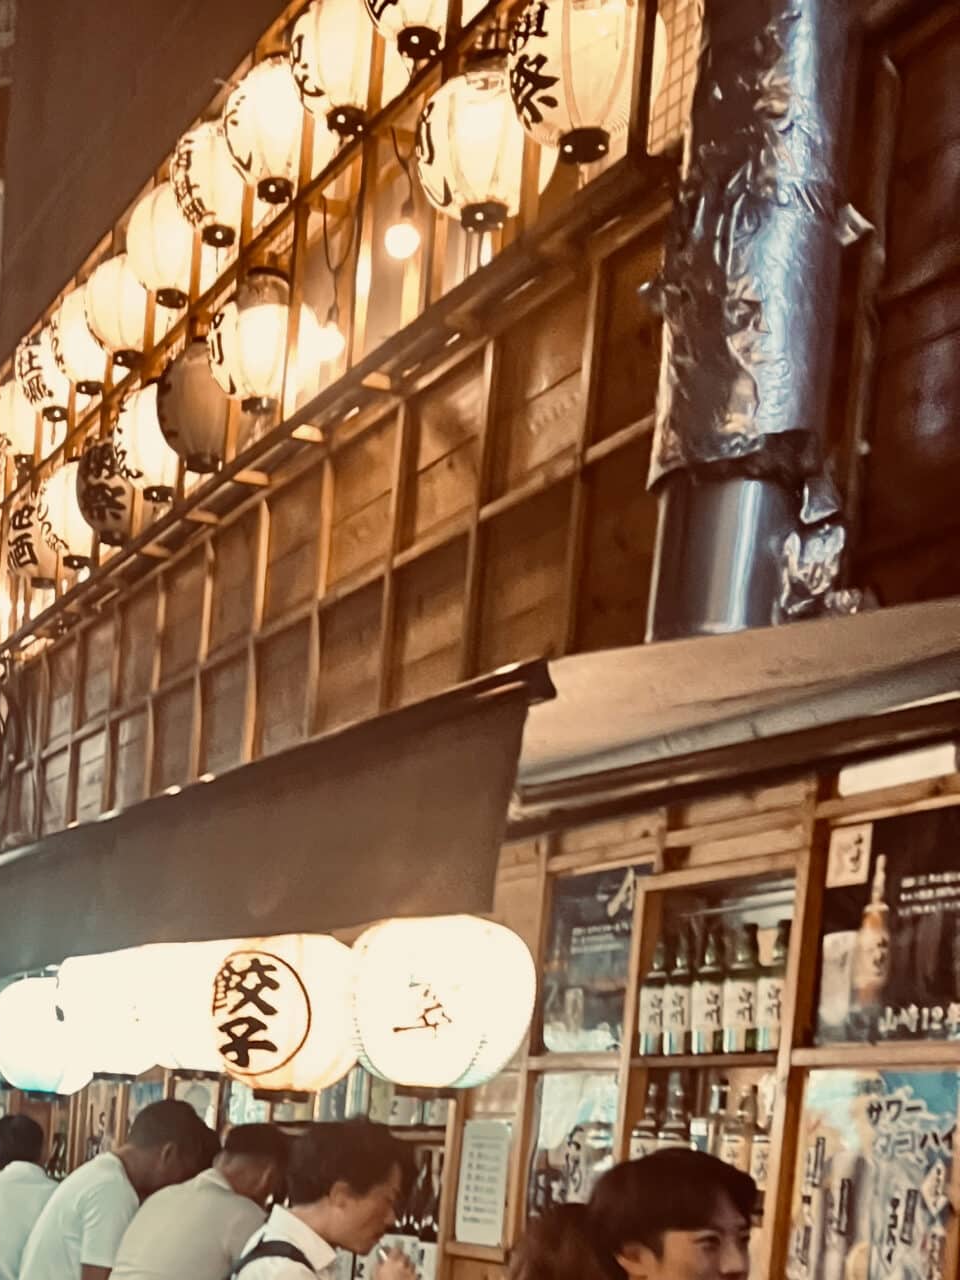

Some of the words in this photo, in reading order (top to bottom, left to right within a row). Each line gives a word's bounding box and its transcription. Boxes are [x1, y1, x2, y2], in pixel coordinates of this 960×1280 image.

[212, 957, 281, 1068] 餃子
[867, 1099, 923, 1126] サワー
